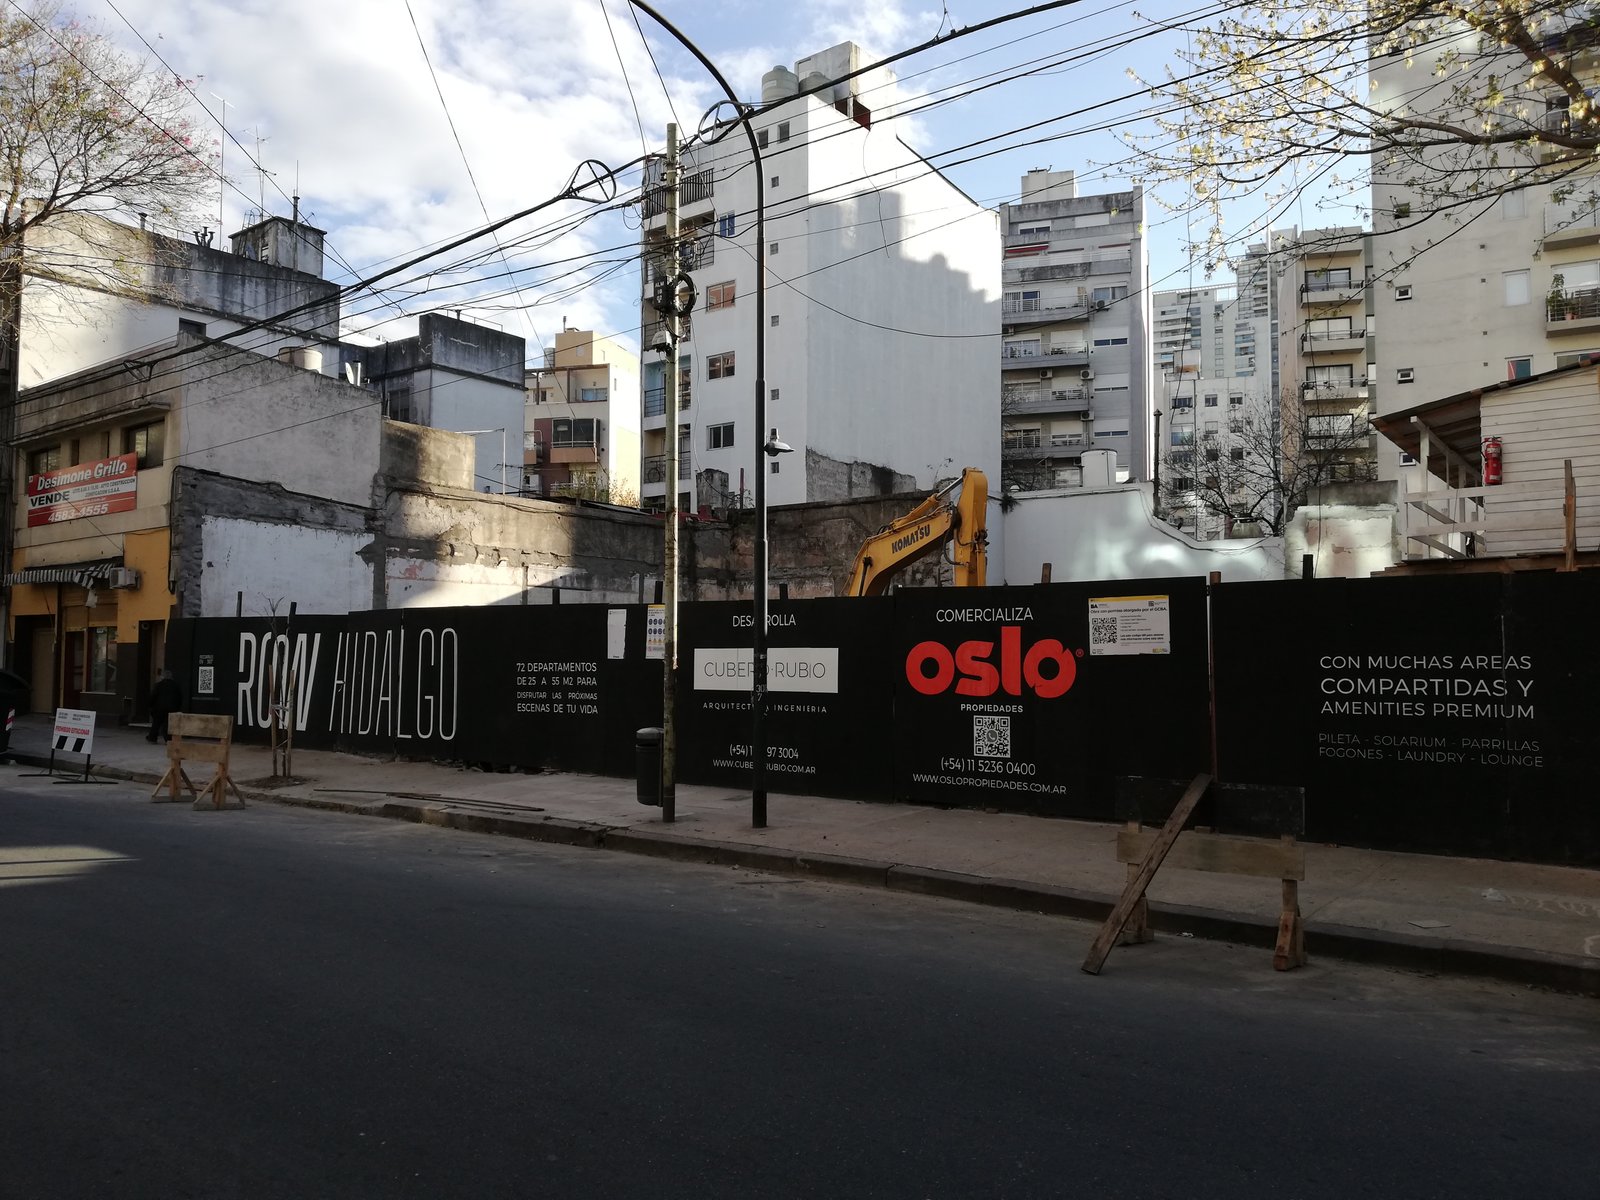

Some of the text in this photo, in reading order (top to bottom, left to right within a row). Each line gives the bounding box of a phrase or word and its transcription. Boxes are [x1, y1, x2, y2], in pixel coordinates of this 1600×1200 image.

[37, 468, 92, 491] Desimone
[94, 459, 127, 479] Grillo
[30, 491, 70, 507] VENDE
[48, 503, 109, 523] 4583-4555
[892, 524, 931, 554] KOMATSU
[732, 614, 797, 628] DESROLLA
[936, 607, 1034, 622] COMERCIALIZA
[516, 662, 597, 672] 72 DEPARTAMENTOS
[905, 626, 1077, 698] oslo
[1319, 655, 1532, 670] CON MUCHAS AREAS
[237, 627, 458, 741] ROW HIDALGO
[516, 677, 598, 686] DE 25 A 55 M2 PARA
[1320, 677, 1534, 697] COMPARTIDAS Y
[516, 690, 598, 700] DISFRUTAR LAS PRÓXIMAS
[516, 703, 598, 714] ESCENAS DE TU VIDA
[703, 702, 828, 713] ARQUITECT INGENIERIA
[960, 703, 1024, 713] PROPIEDADES
[1320, 701, 1535, 719] AMENITIES PREMIUM
[1318, 733, 1361, 745] PILETA
[1373, 735, 1447, 748] SOLARIUM
[1461, 738, 1540, 752] PARRILLAS
[778, 747, 800, 760] 3004
[1319, 747, 1384, 760] FOGONES
[1397, 750, 1466, 763] LAUNDRY
[1480, 753, 1544, 768] LOUNGE
[940, 756, 1037, 776] (+54) 11 5236 0400
[912, 773, 1068, 795] WWW.OSLOPROPIEDADES.COM.AR
